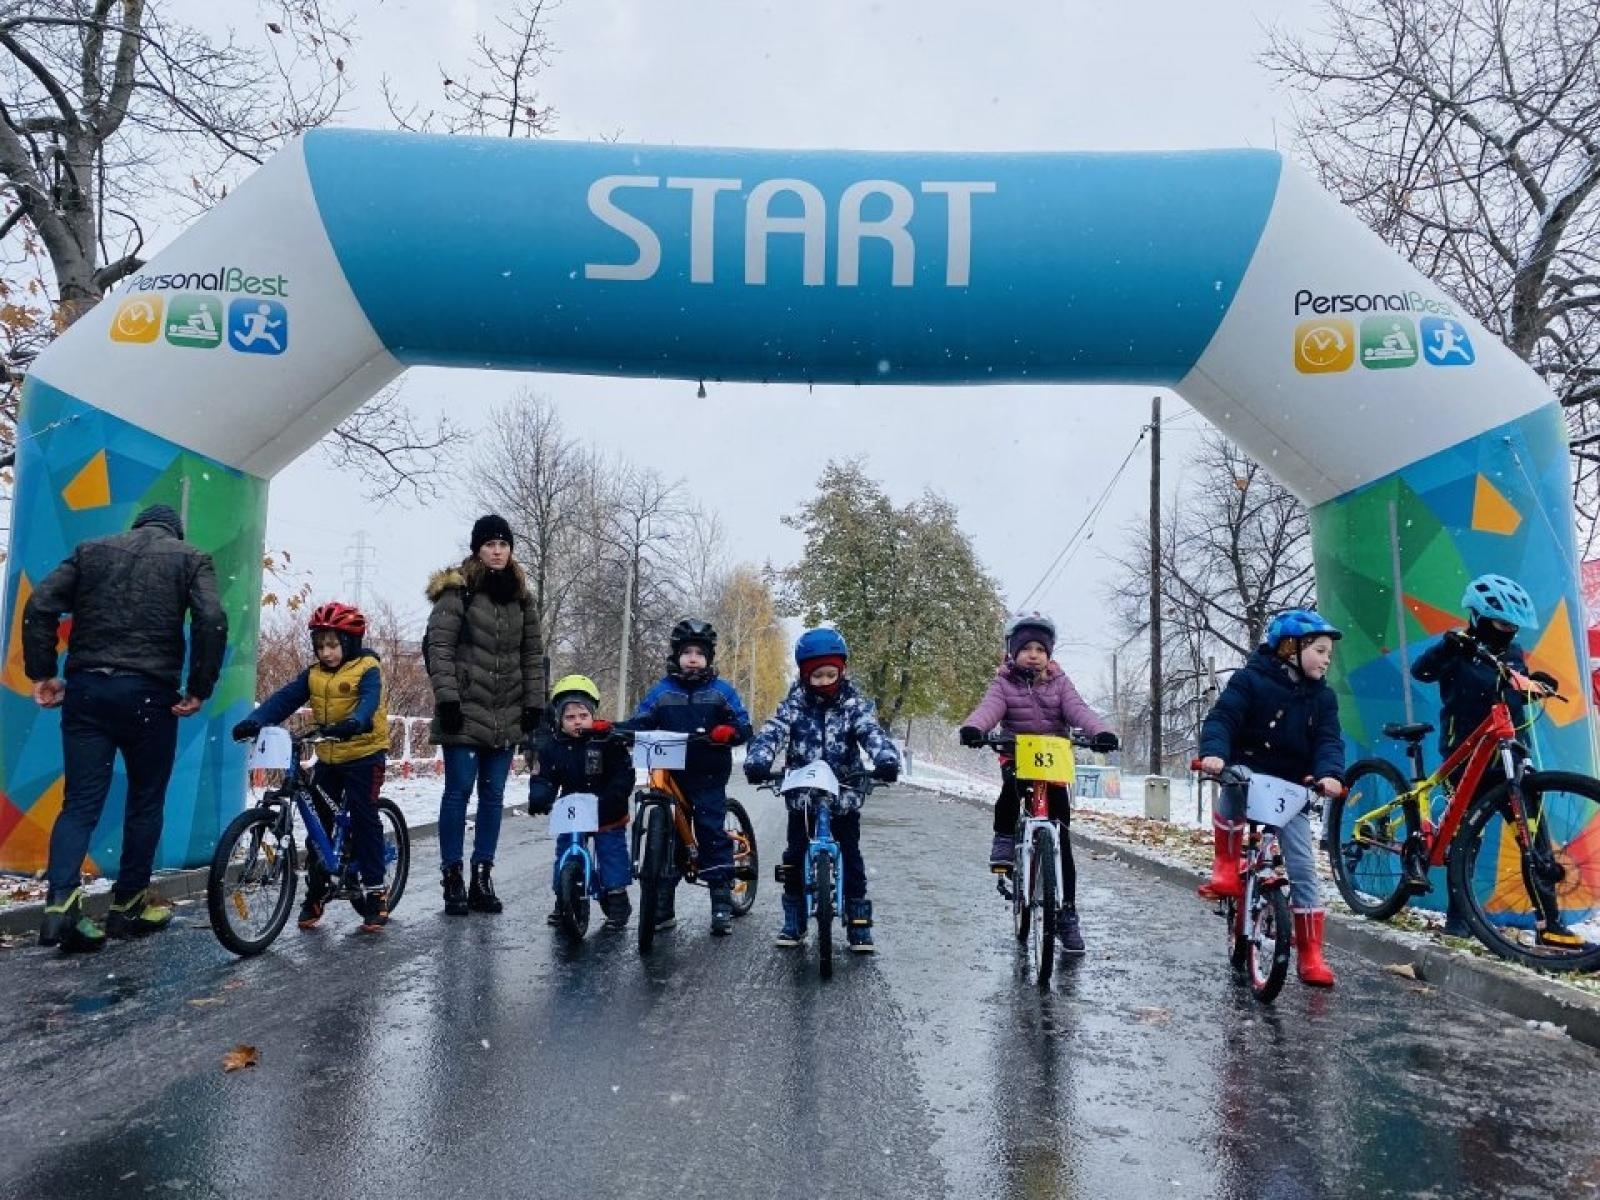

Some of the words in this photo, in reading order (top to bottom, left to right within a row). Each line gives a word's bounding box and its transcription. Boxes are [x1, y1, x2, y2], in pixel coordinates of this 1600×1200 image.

[584, 174, 997, 287] START
[127, 266, 289, 298] PersonalBest
[1294, 289, 1457, 317] PersonalBes
[1034, 752, 1054, 768] 83
[567, 806, 576, 820] 8
[1275, 797, 1286, 814] 3
